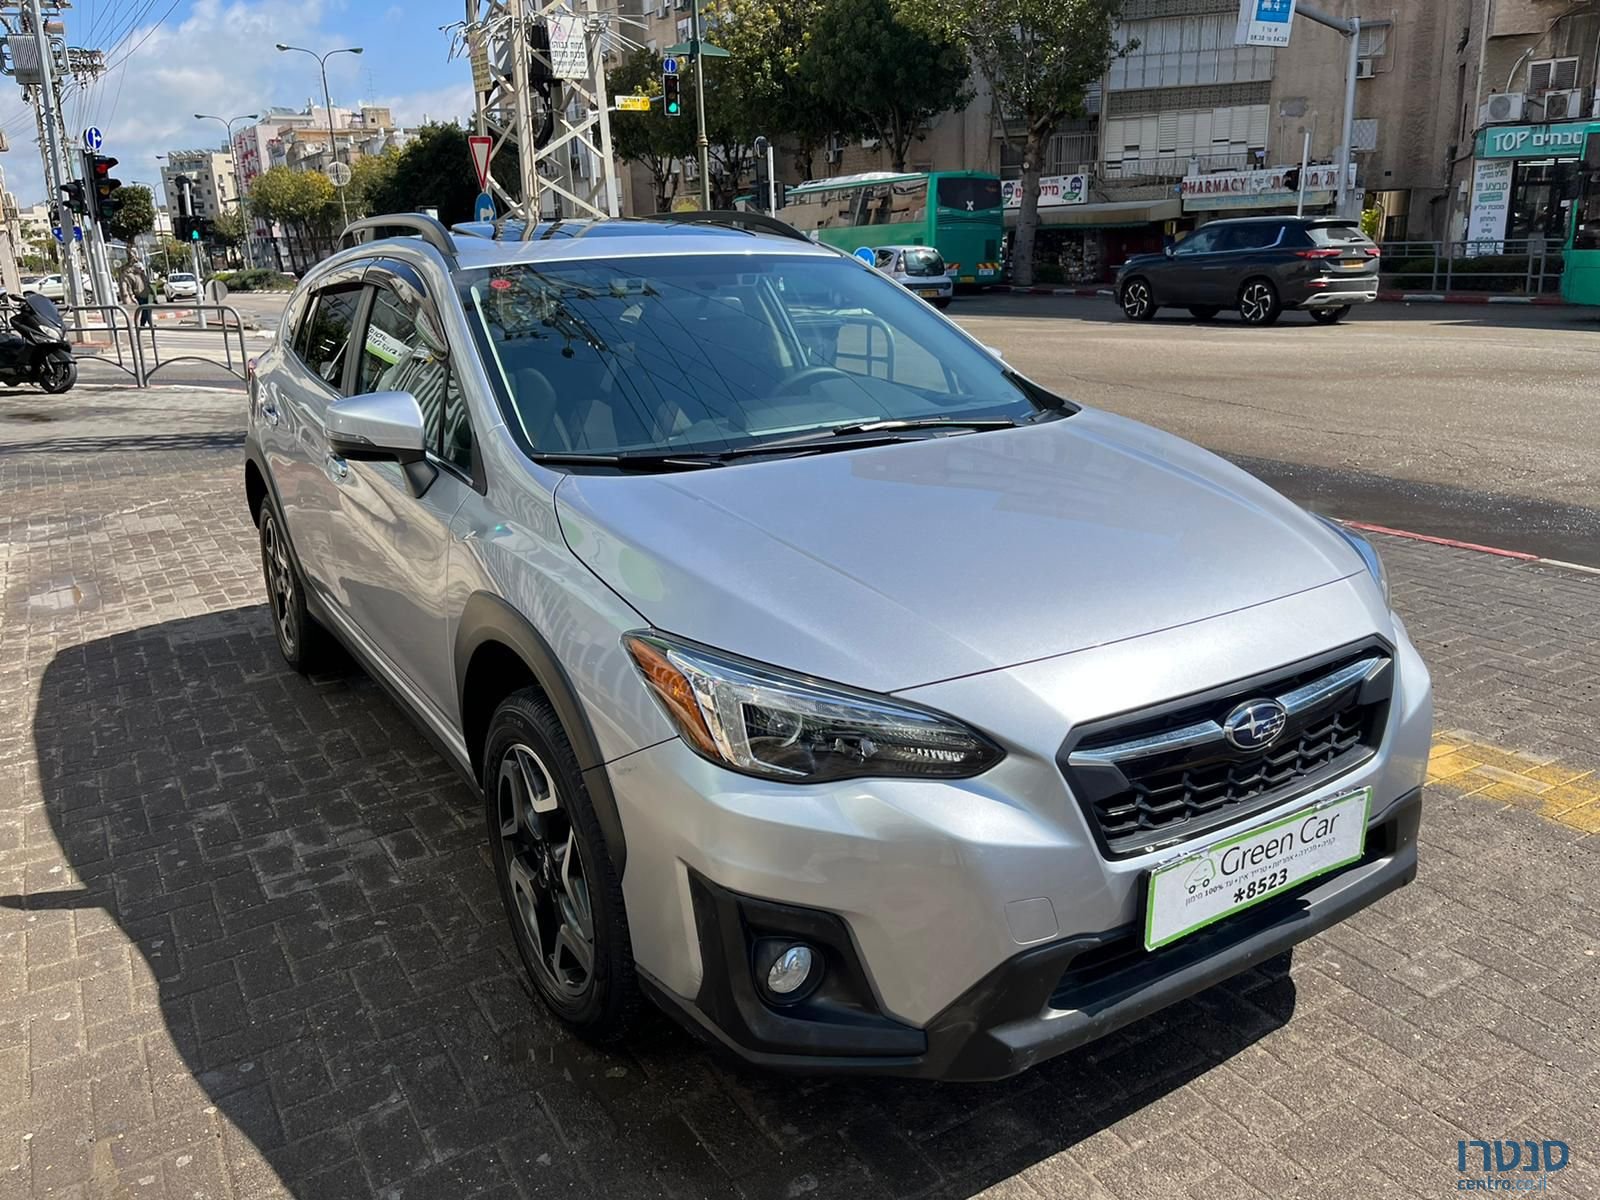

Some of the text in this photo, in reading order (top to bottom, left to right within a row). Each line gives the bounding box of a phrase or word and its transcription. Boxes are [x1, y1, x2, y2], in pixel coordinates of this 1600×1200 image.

[1493, 131, 1529, 151] TOP
[1532, 131, 1584, 146] טבחים
[1041, 185, 1059, 196] מיני
[1182, 177, 1247, 194] PHARMACY
[1221, 813, 1340, 876] Green Car
[1272, 855, 1295, 869] אחריות
[1251, 865, 1268, 877] טרייד
[1238, 873, 1249, 884] אין
[1204, 884, 1224, 897] 100%
[1185, 892, 1203, 907] מימון
